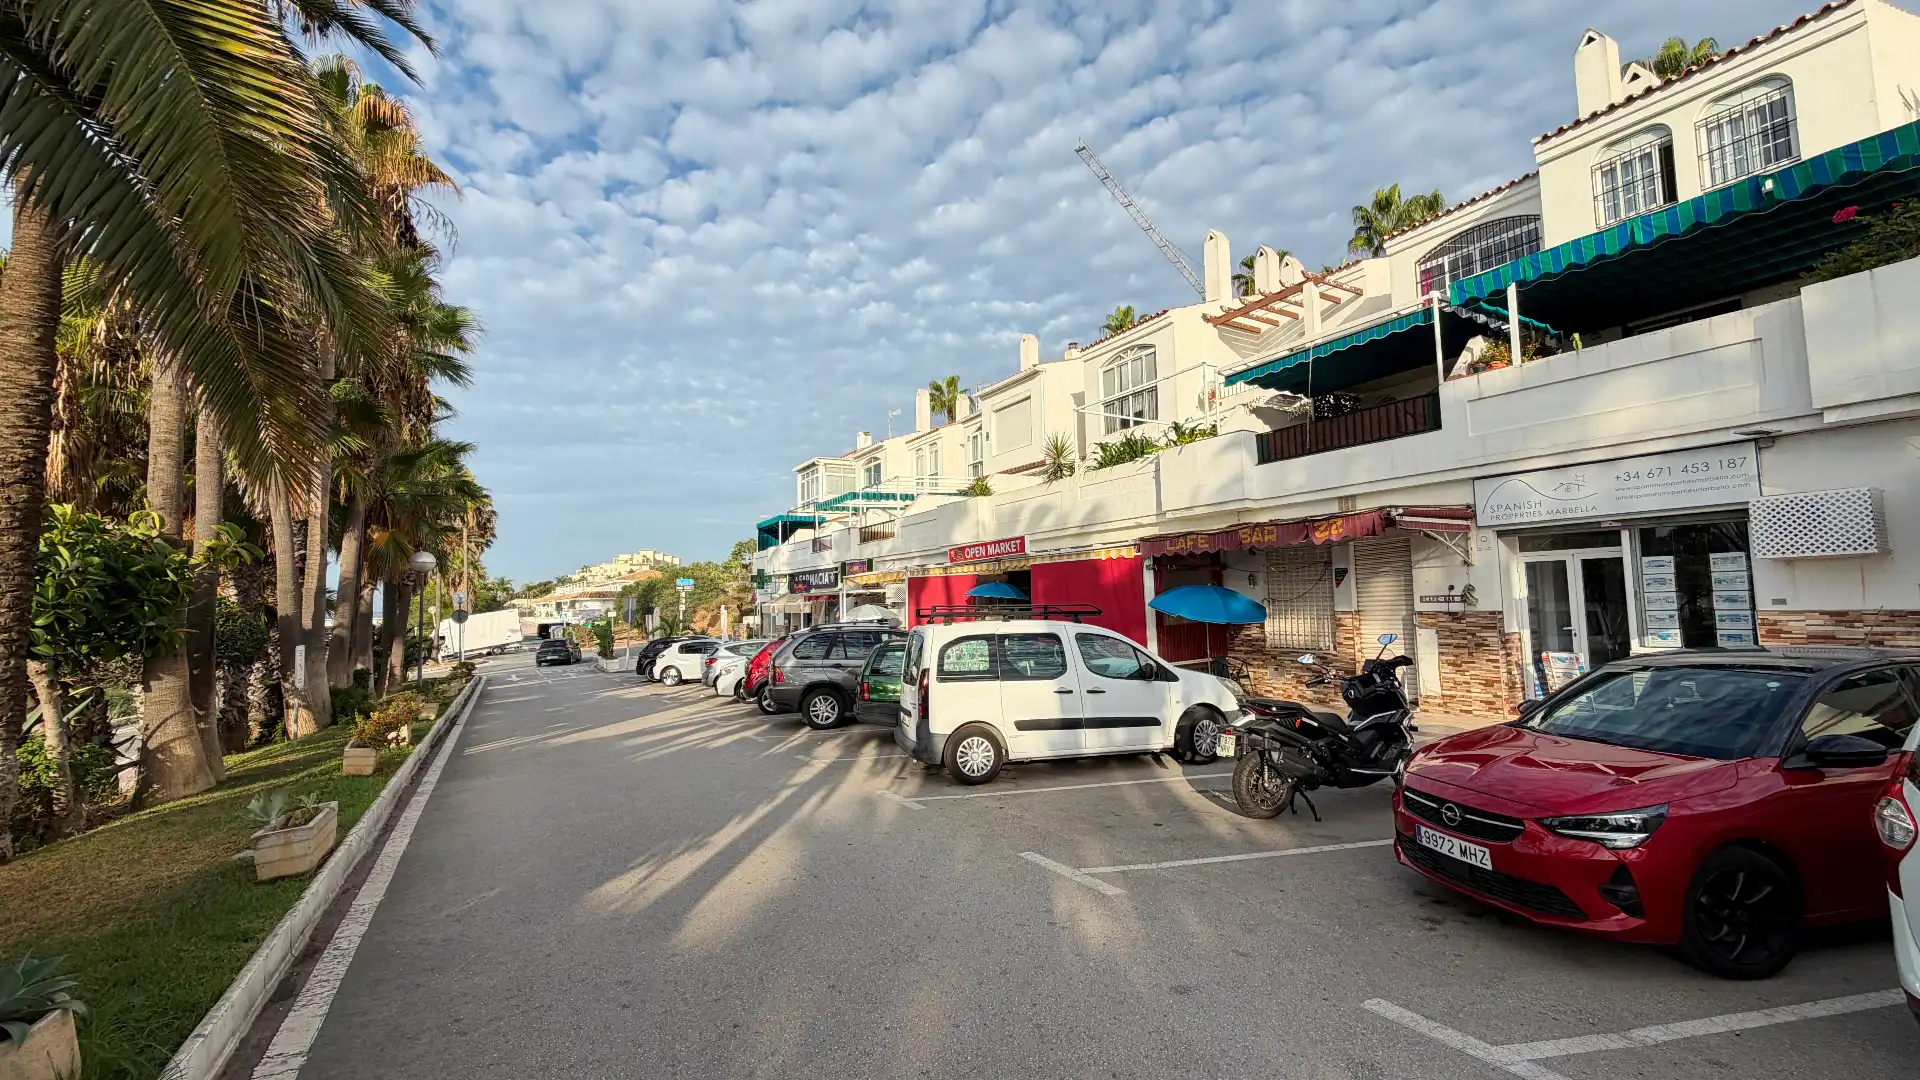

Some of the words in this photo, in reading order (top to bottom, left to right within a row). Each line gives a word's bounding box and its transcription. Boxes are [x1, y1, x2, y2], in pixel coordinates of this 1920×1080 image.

[1614, 471, 1641, 483] +34
[1646, 466, 1672, 479] 671
[1681, 461, 1710, 474] 453
[1718, 456, 1747, 470] 187
[1489, 500, 1542, 514] SPANISH
[1490, 511, 1543, 521] PROPERTIES
[1546, 505, 1598, 516] MARBELLA
[964, 545, 986, 559] OPEN
[987, 540, 1021, 556] MARKET
[1423, 830, 1455, 855] 9972
[1459, 842, 1488, 866] MHZ
